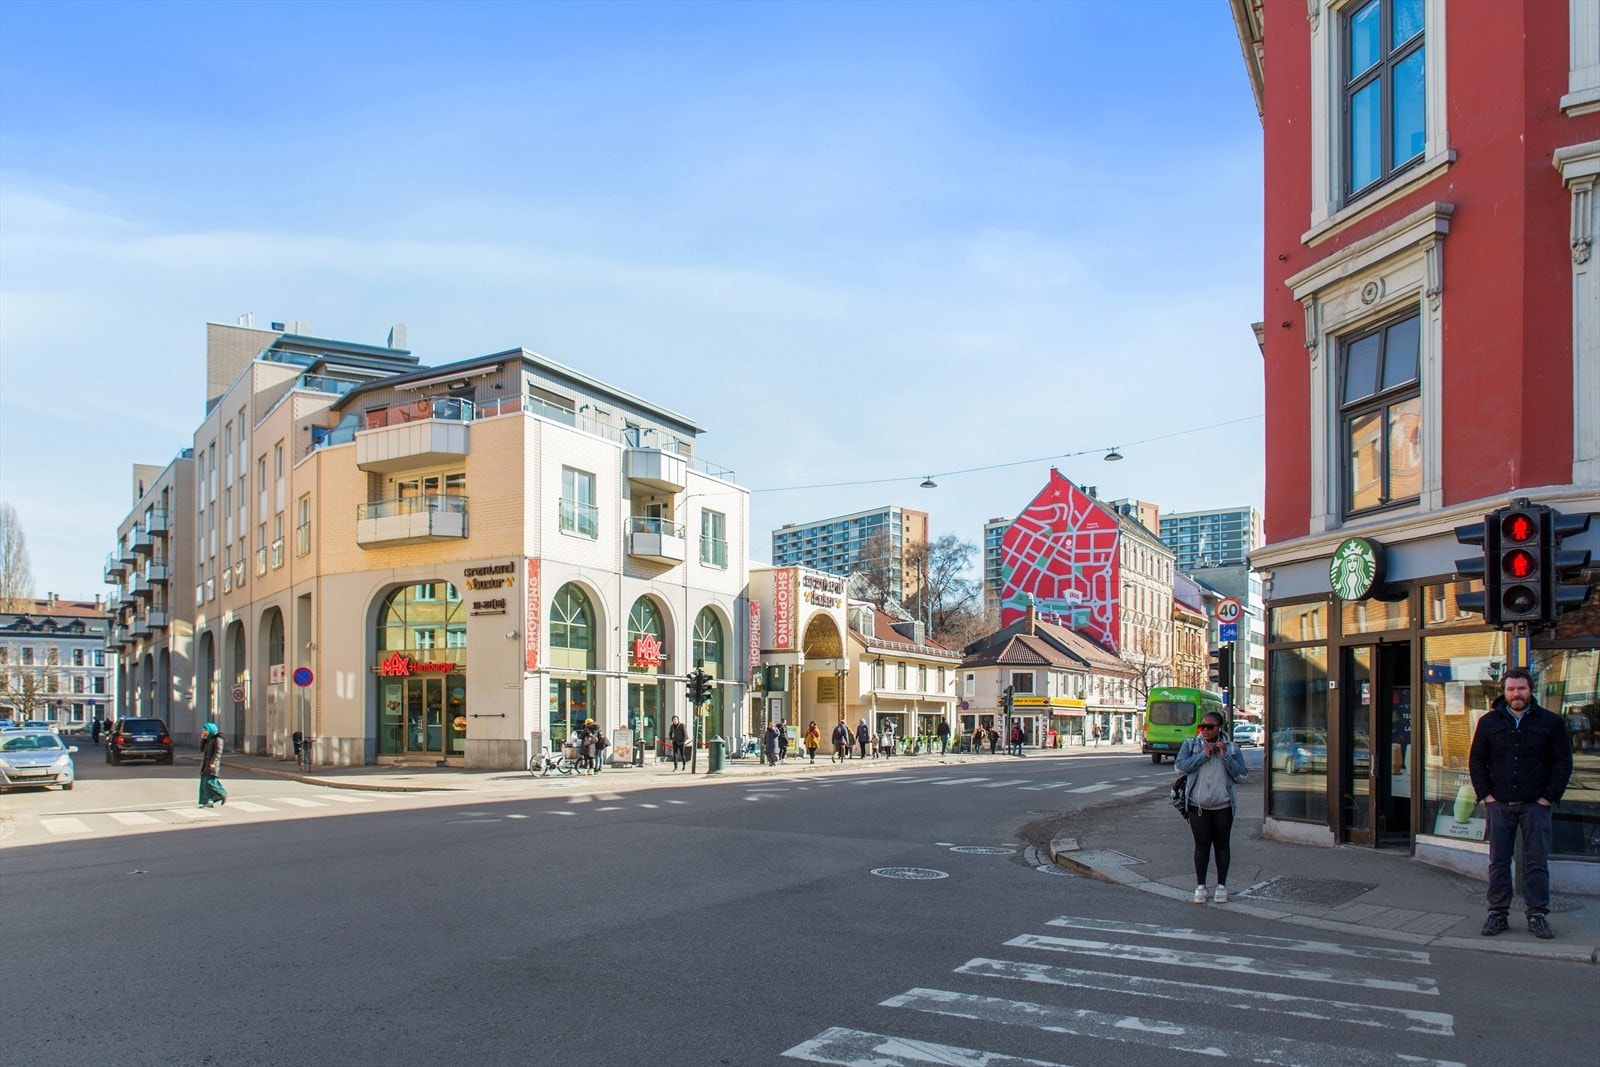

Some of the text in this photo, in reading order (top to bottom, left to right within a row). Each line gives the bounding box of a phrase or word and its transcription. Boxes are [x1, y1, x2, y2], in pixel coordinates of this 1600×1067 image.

[528, 576, 538, 651] SHOPPING
[778, 571, 788, 645] SHOPPING
[1219, 604, 1238, 617] 40
[634, 634, 662, 660] MAX
[382, 651, 408, 676] MAX
[1169, 694, 1187, 702] bring
